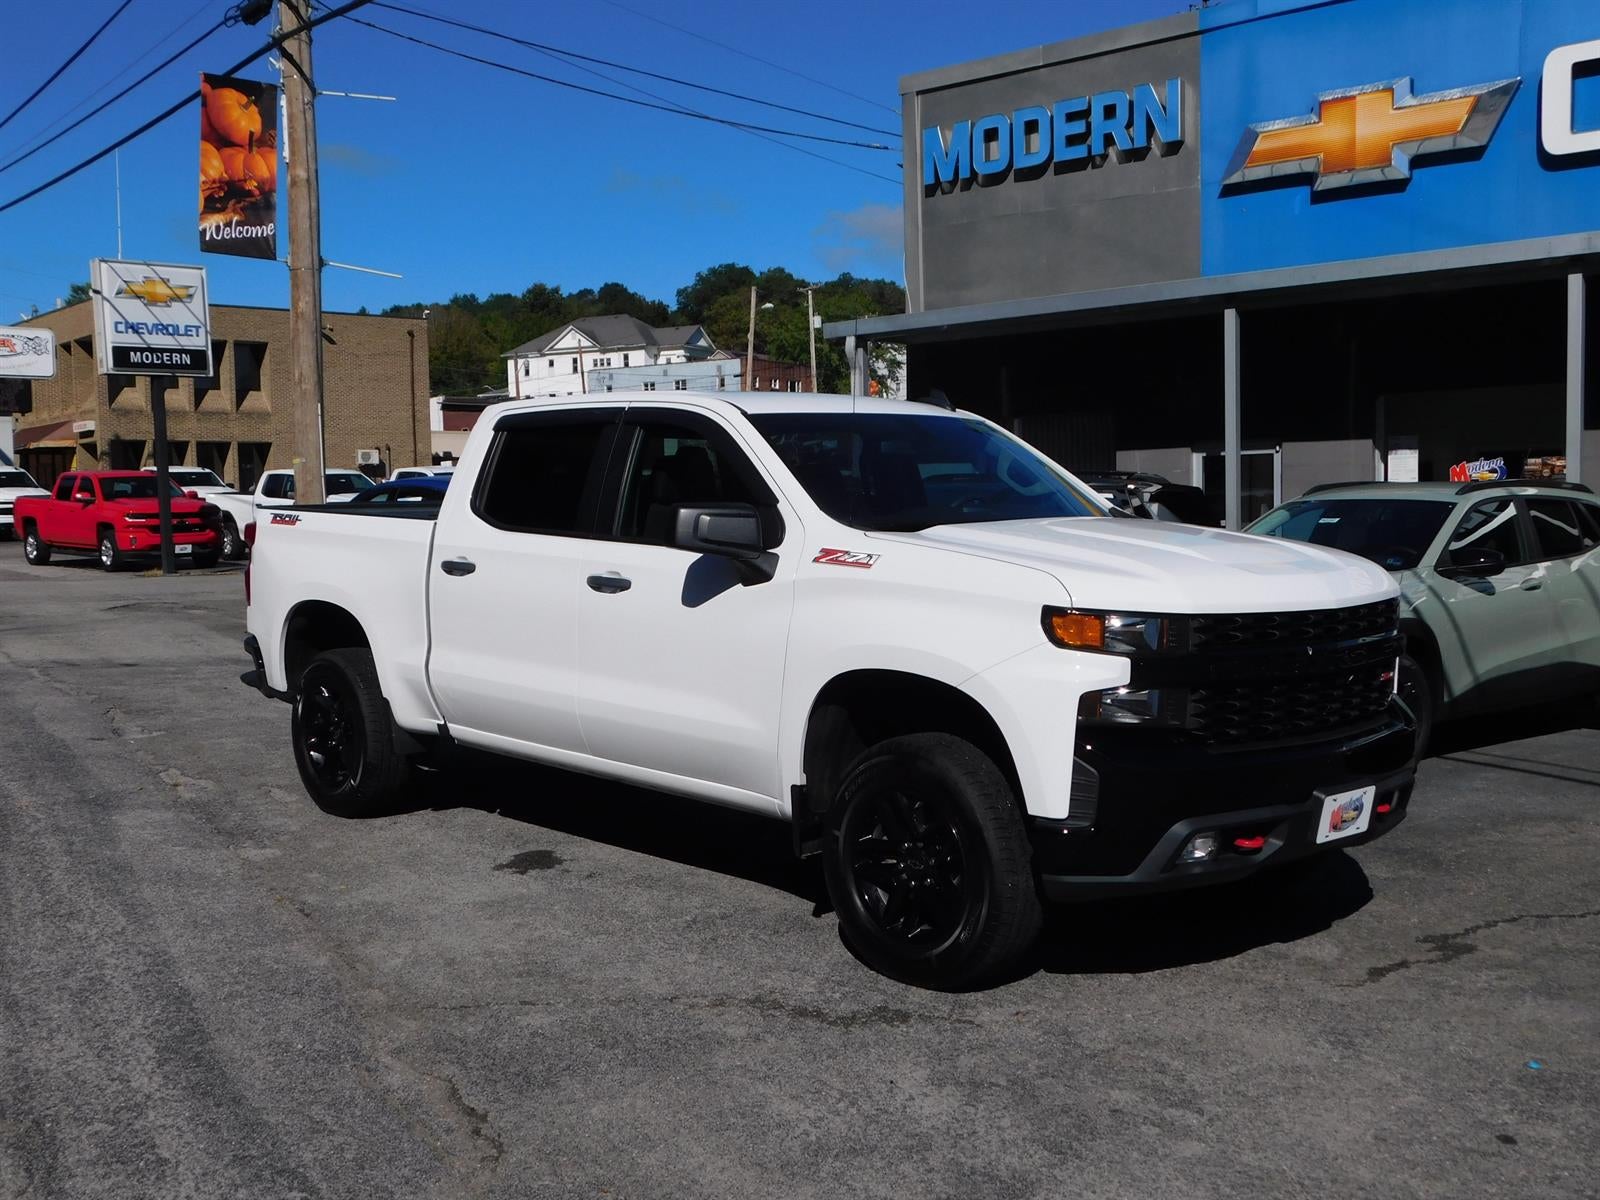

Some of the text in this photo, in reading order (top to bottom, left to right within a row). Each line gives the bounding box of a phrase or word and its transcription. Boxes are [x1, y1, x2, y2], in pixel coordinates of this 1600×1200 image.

[923, 76, 1184, 185] MODERN
[199, 216, 275, 241] Welcome
[114, 320, 202, 337] CHEVROLET
[129, 351, 191, 365] MODERN
[1450, 457, 1504, 482] Modern
[812, 547, 880, 568] Z71
